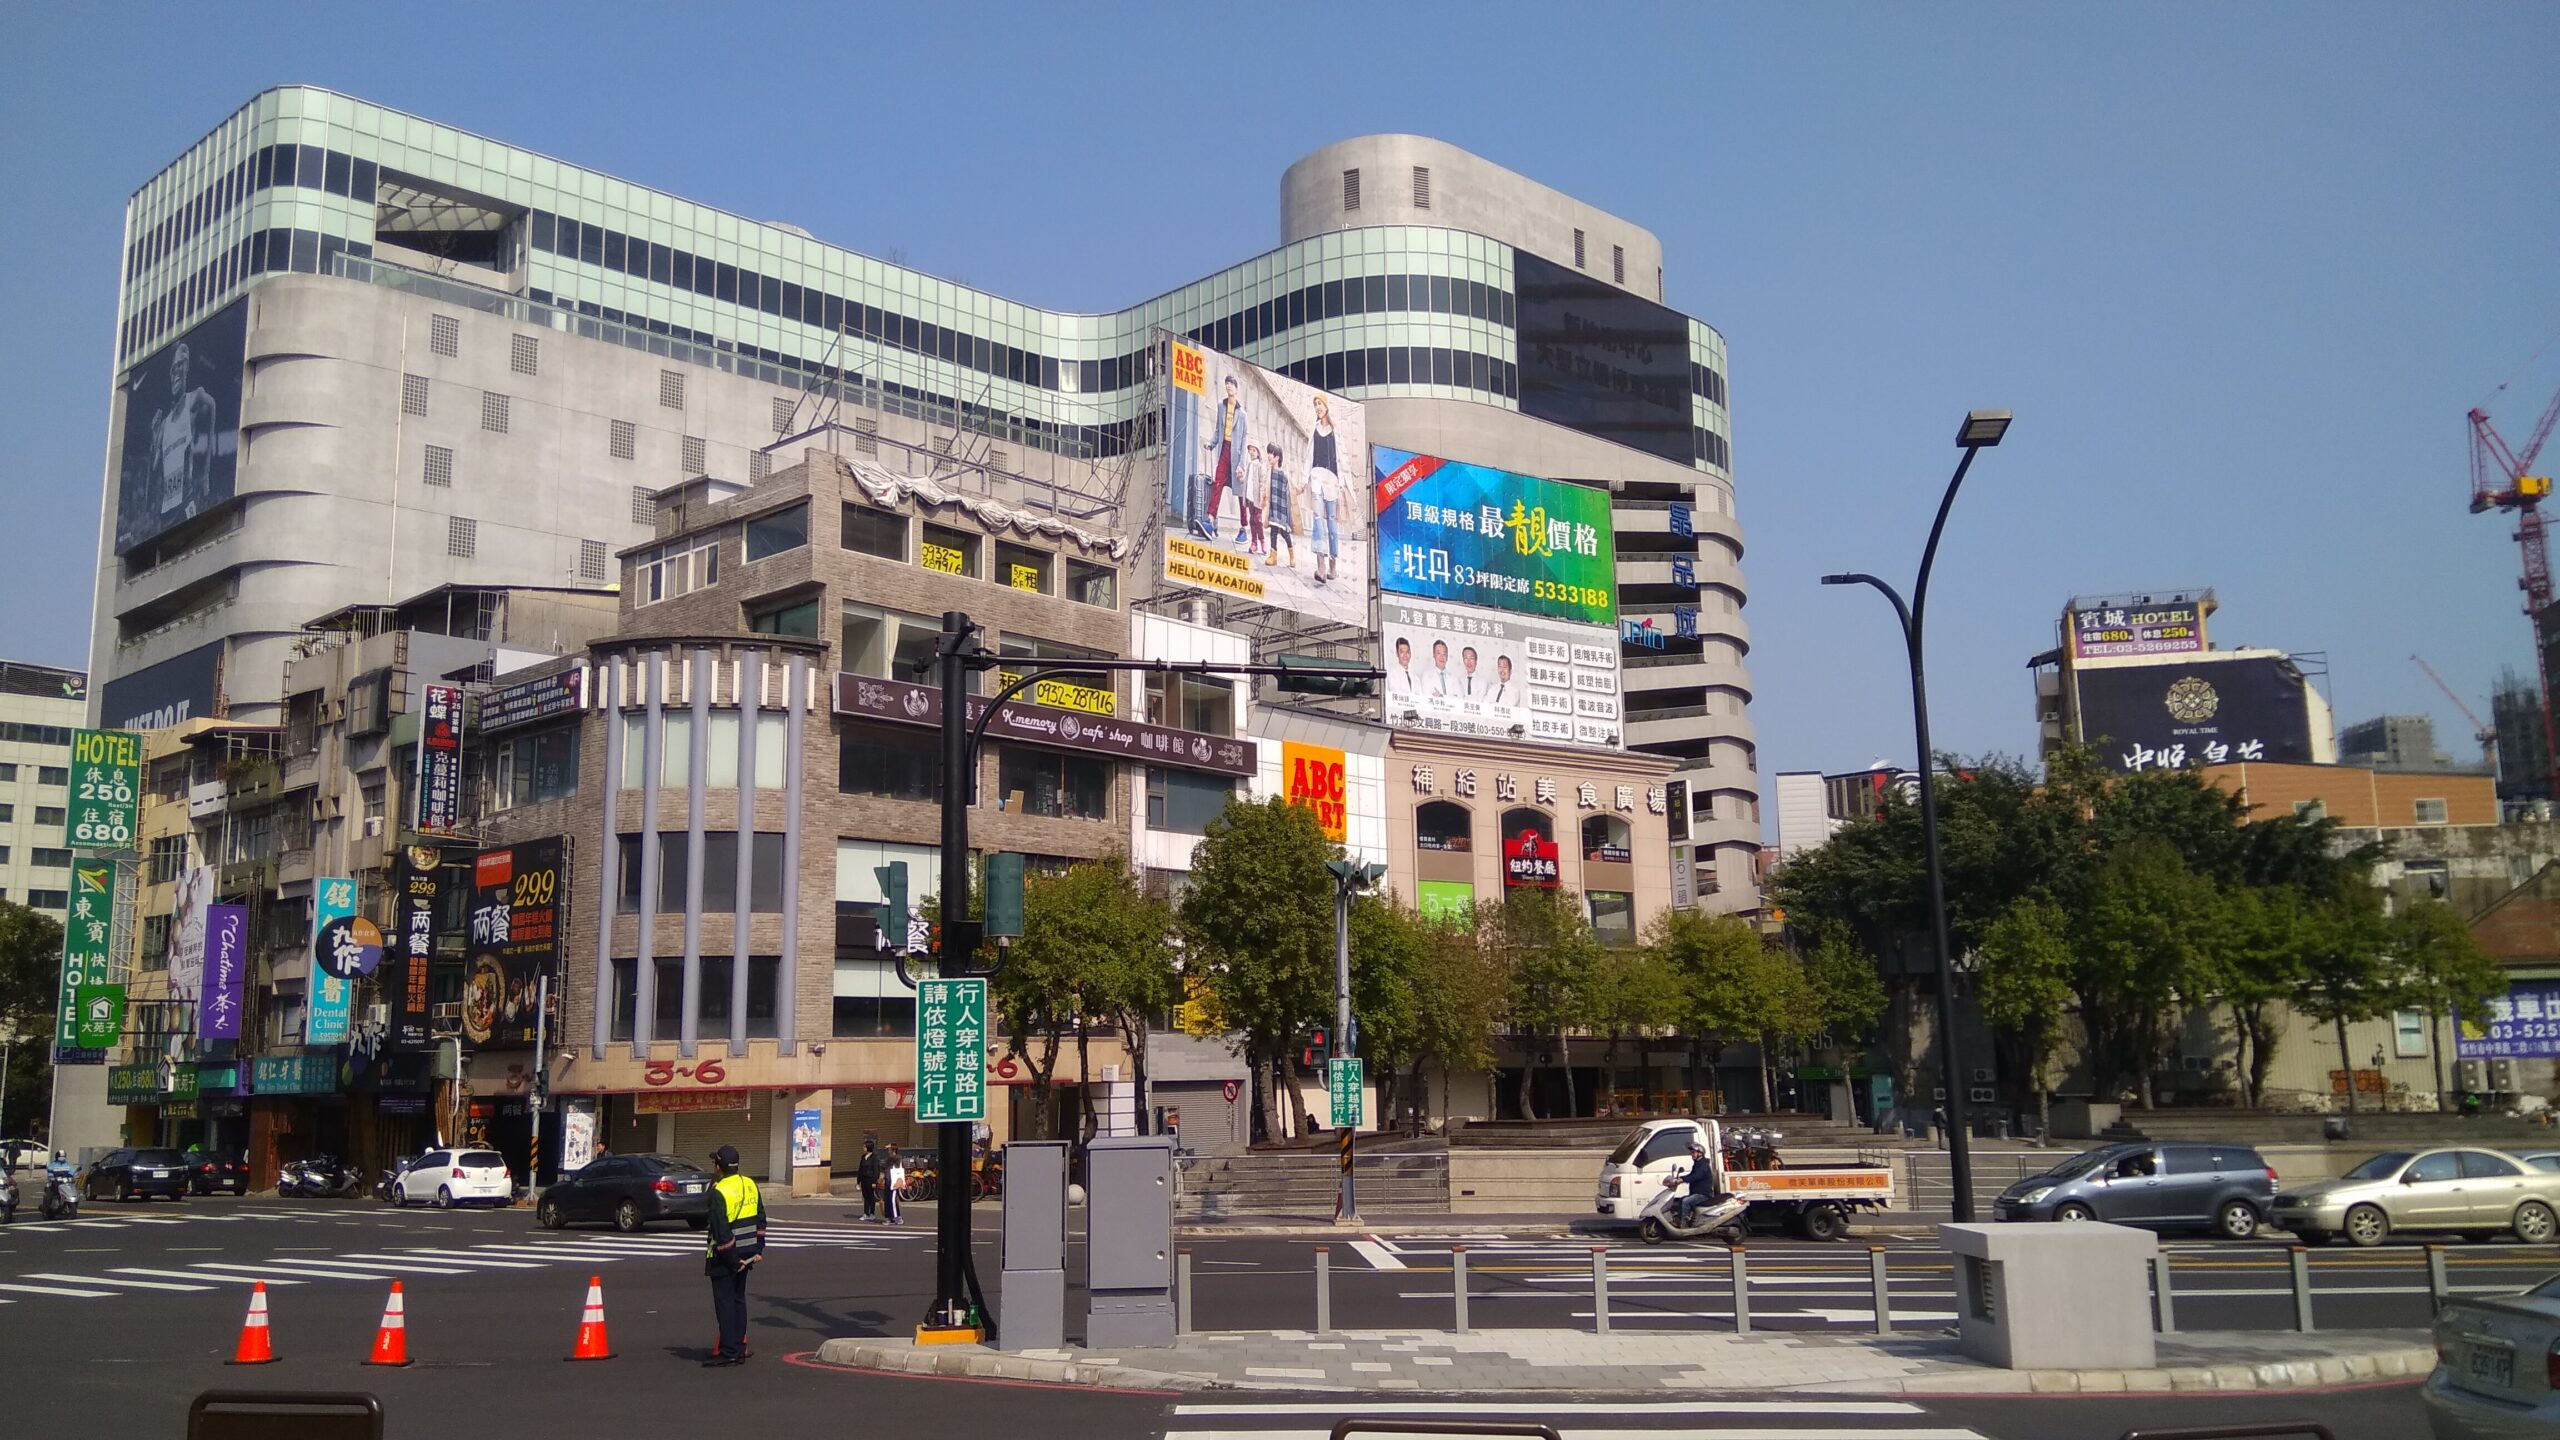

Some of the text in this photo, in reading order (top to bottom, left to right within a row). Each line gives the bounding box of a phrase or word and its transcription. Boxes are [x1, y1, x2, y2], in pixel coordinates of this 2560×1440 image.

[1175, 349, 1203, 376] ABC
[1175, 368, 1203, 389] MART
[1406, 498, 1598, 557] 頂級規格 最靚價格
[1169, 539, 1249, 571] HELLO TRAVEL
[1025, 571, 1037, 590] 租
[1169, 562, 1264, 596] HELLO VACATION
[1403, 544, 1451, 584] 牡丹
[1534, 579, 1608, 608] 5333188
[1400, 609, 1505, 637] 凡登醫美整形外科
[2080, 609, 2194, 629] 賓城 HOTEL
[2083, 640, 2198, 655] TEL:03-5269255
[1530, 667, 1566, 684] 隆鼻手術
[1531, 693, 1567, 709] 削骨手術
[1002, 709, 1057, 735] K.memory
[1109, 728, 1133, 748] shop
[1532, 719, 1568, 735] 拉皮手術
[2172, 726, 2219, 736] ROYAL TIME
[75, 732, 139, 767] HOTEL
[1141, 731, 1184, 755] 咖啡館
[84, 766, 128, 786] 休息
[1290, 757, 1344, 802] ABC
[78, 783, 132, 803] 250
[1413, 764, 1667, 815] 補給站美食廣場
[81, 807, 125, 825] 住宿
[75, 823, 129, 842] 680
[1510, 858, 1557, 876] 紐約餐廳
[408, 881, 436, 895] 299
[513, 869, 555, 907] 299
[219, 929, 237, 991] Chatime
[63, 953, 84, 1040] HOTEL
[314, 1007, 347, 1018] Dental
[315, 1018, 344, 1029] Clinic
[81, 1021, 116, 1033] 大苑子
[2491, 1023, 2560, 1039] 03-525
[922, 984, 948, 1118] 請依燈號行止
[955, 983, 980, 1115] 行人穿越路口
[644, 1058, 726, 1086] 3~6
[1332, 1060, 1346, 1125] 請依燈號行止
[1347, 1060, 1360, 1124] 行人穿越路口
